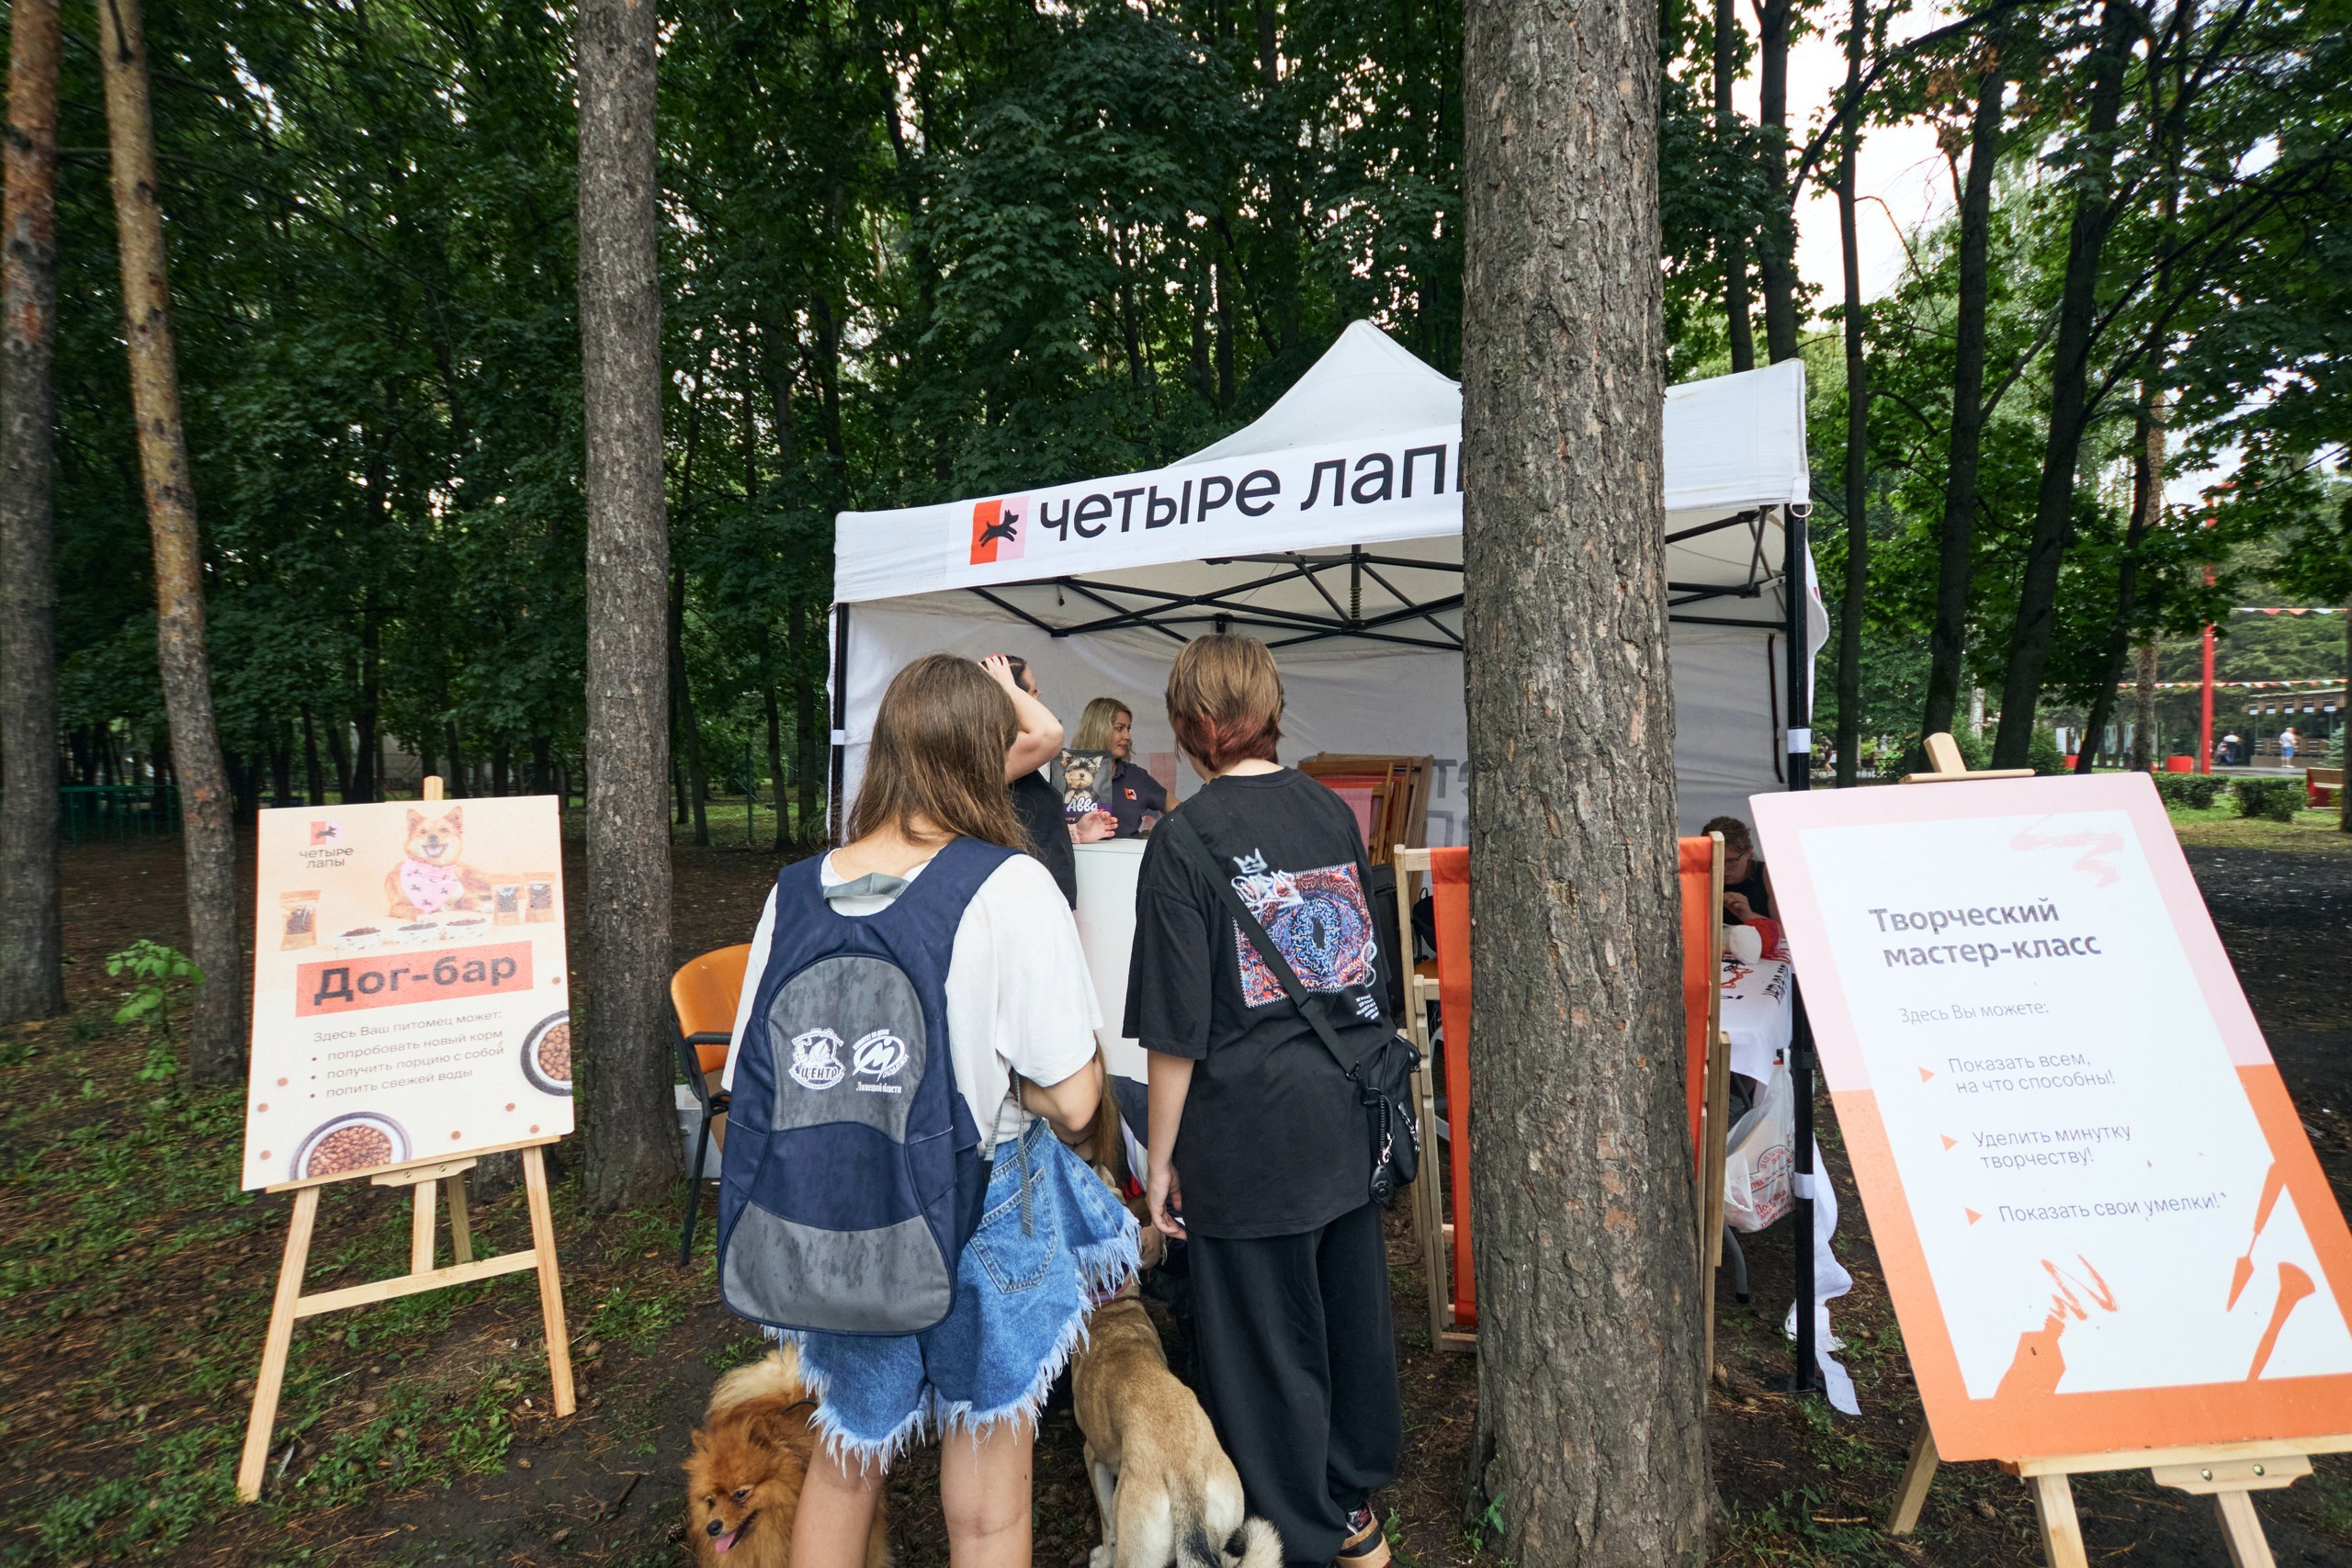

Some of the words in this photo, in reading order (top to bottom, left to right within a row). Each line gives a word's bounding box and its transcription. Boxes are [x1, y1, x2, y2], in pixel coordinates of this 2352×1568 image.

[1040, 468, 1281, 542] четыре
[1301, 443, 1464, 512] лап
[1066, 796, 1098, 812] Abba
[300, 847, 354, 859] четыре
[306, 857, 345, 869] лапы
[1869, 898, 2061, 935] Творческий
[1883, 931, 2102, 969] мастер-класс
[314, 955, 517, 1007] Дог-бар
[1899, 1006, 1950, 1025] Здесь
[1951, 1003, 1976, 1021] Вы
[1980, 998, 2050, 1019] можете:
[313, 1029, 356, 1043] Здесь
[360, 1024, 390, 1038] Ваш
[393, 1017, 453, 1034] питомец
[456, 1010, 503, 1026] может:
[328, 1040, 420, 1061] попробовать
[424, 1032, 467, 1048] новый
[469, 1030, 503, 1043] корм
[327, 1061, 393, 1079] получить
[396, 1055, 451, 1069] порцию
[454, 1052, 462, 1061] с
[464, 1045, 504, 1059] собой
[799, 1066, 838, 1081] ЦЕНТР
[1949, 1052, 2035, 1074] Показать
[2039, 1050, 2092, 1072] всем,
[326, 1082, 379, 1098] попить
[381, 1073, 435, 1089] свежей
[438, 1069, 473, 1080] воды
[1957, 1077, 1980, 1094] на
[1984, 1075, 2014, 1092] что
[2018, 1067, 2116, 1089] способны!
[1973, 1126, 2052, 1149] Уделить
[2054, 1122, 2131, 1147] минутку
[1981, 1146, 2095, 1171] творчеству!
[1999, 1204, 2089, 1224] Показать
[2094, 1199, 2142, 1216] свои
[2144, 1192, 2221, 1216] умелки!
